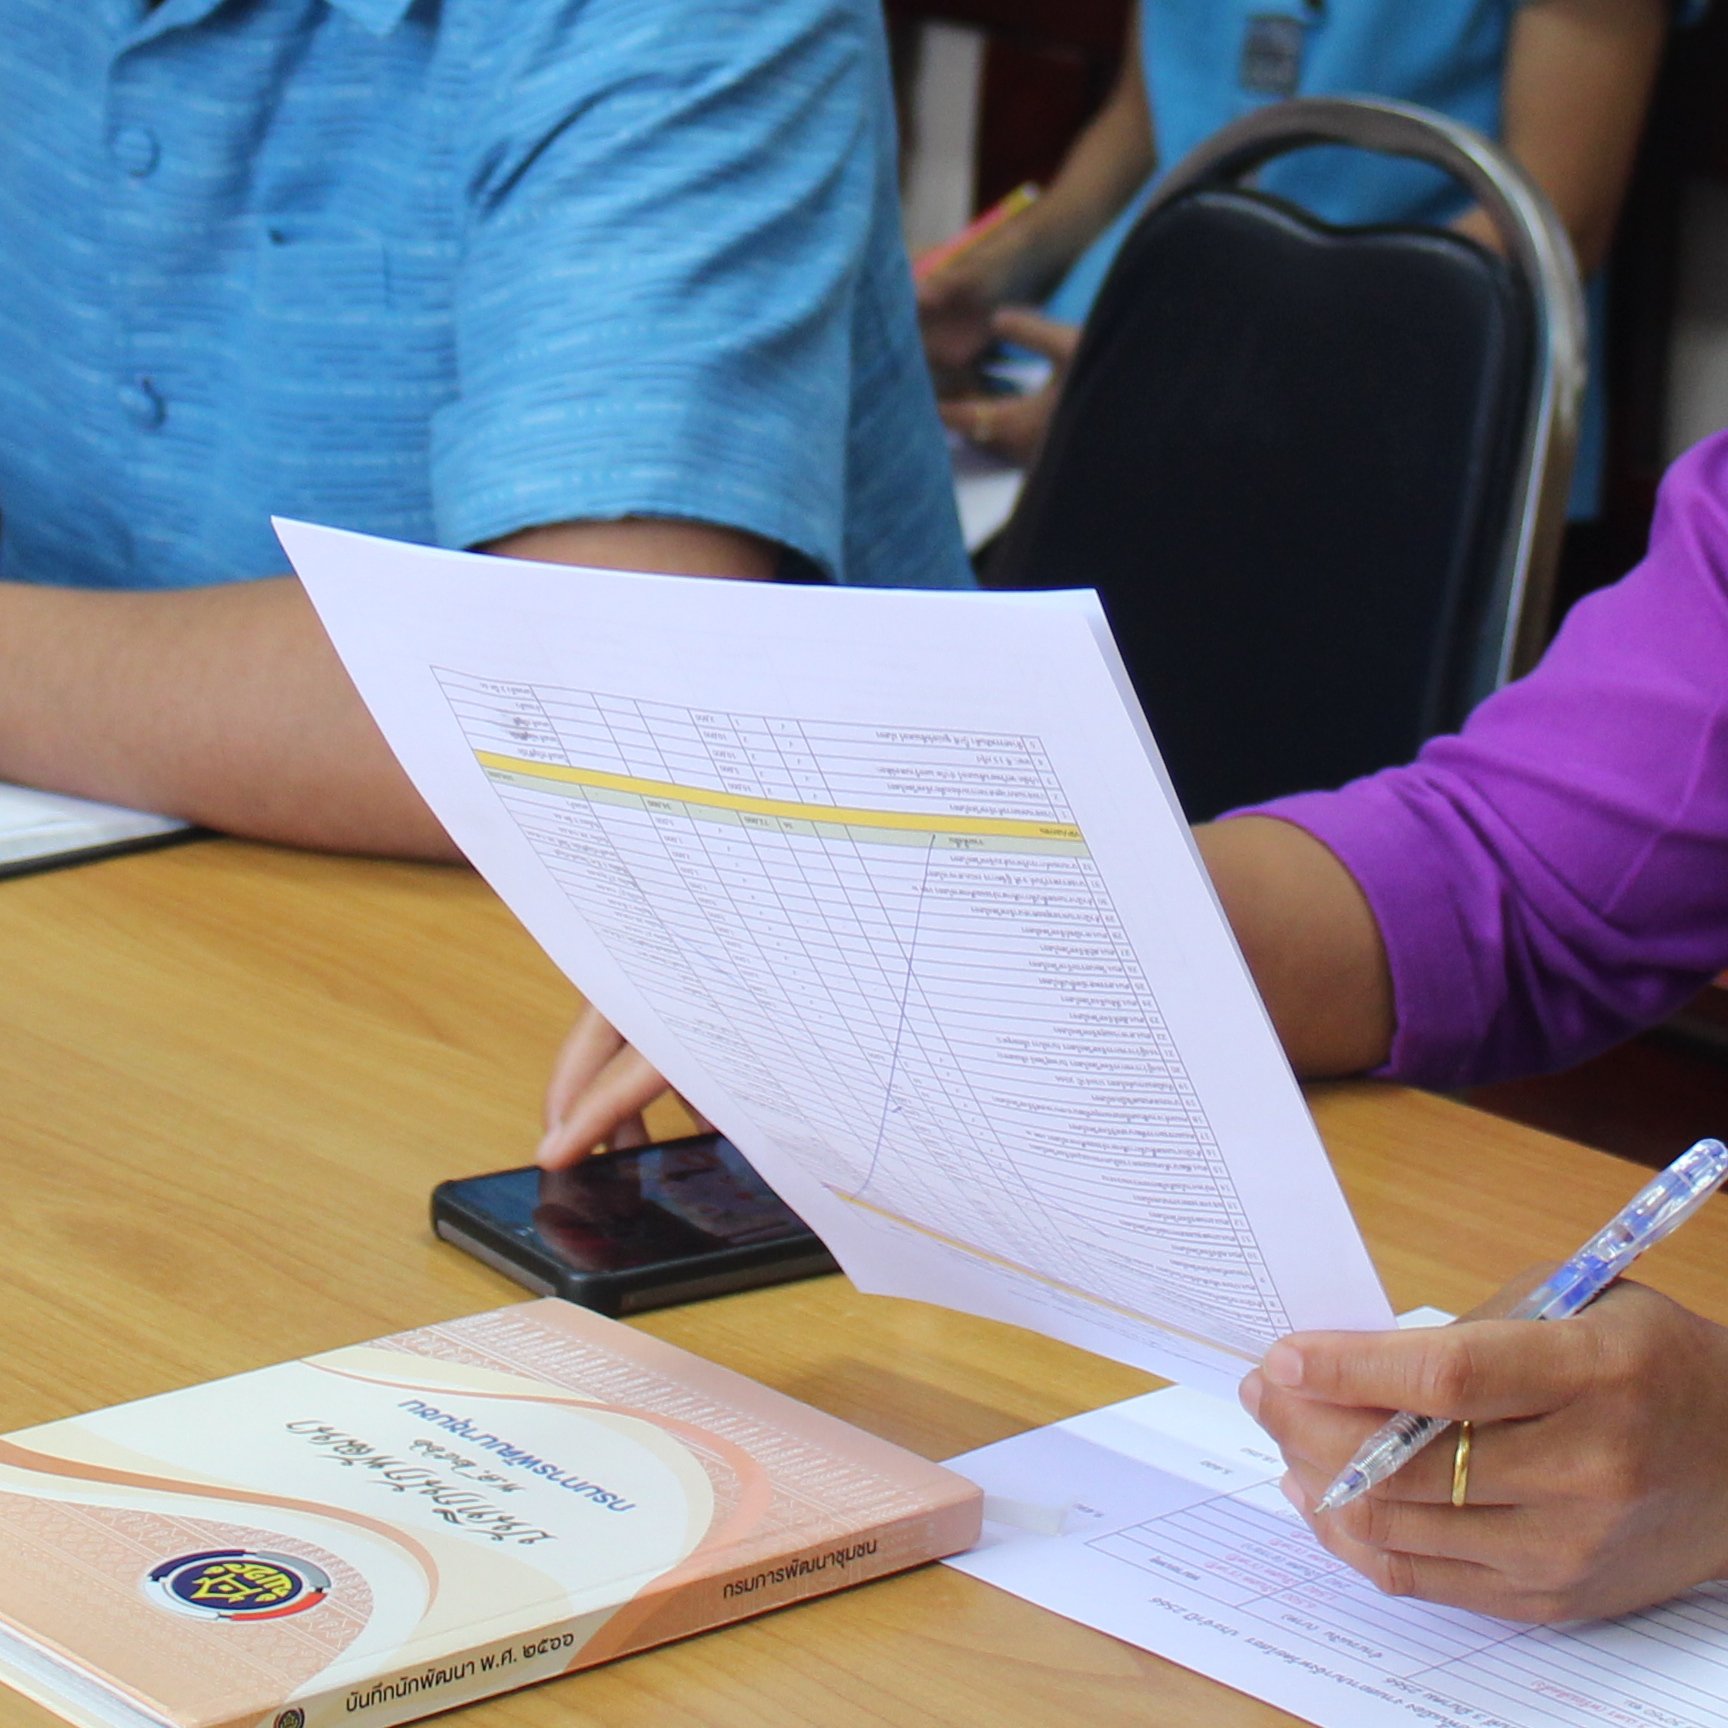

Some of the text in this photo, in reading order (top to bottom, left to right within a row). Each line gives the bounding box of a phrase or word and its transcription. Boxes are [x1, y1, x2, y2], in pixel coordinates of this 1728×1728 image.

[286, 1419, 559, 1546] บันทึกนักพัฒนา
[398, 1399, 637, 1514] กรมการพัฒนาชุมชน
[722, 1538, 878, 1600] กรมการพัฒนาชุมชน
[345, 1631, 575, 1713] บันทึกนักพัฒนา พ.ศ. ๒๕๖๖
